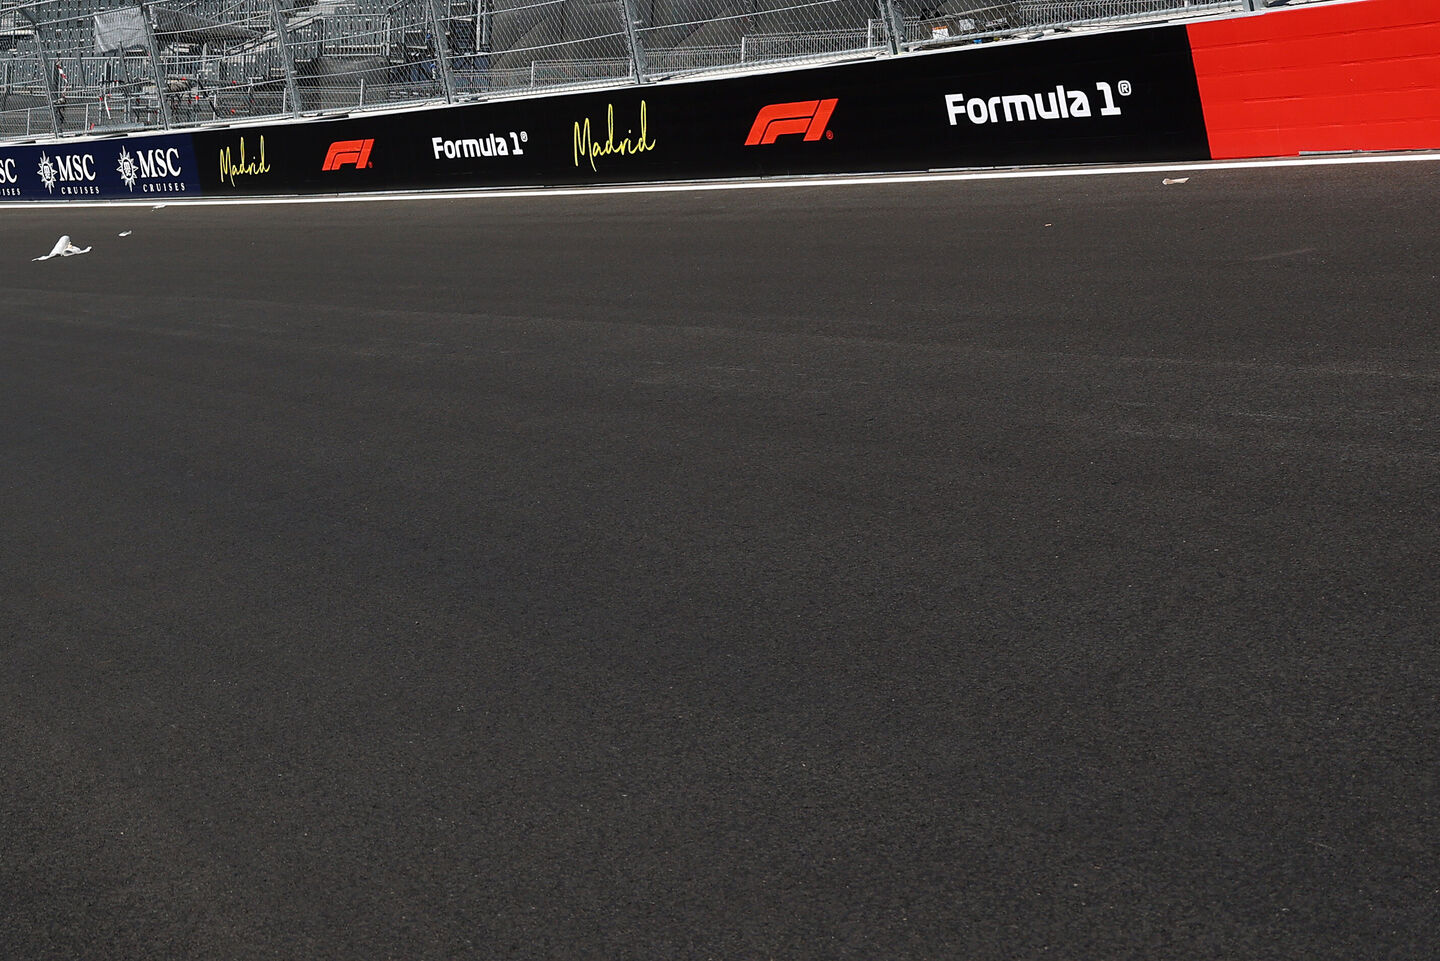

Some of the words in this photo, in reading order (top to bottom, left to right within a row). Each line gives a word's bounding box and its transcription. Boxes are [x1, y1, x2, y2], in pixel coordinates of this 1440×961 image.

[945, 85, 1091, 125] Formula
[432, 133, 508, 159] Formula
[573, 100, 656, 172] Madrid
[54, 154, 95, 181] MSC
[136, 148, 181, 178] MSC
[220, 134, 270, 187] Madrid
[143, 183, 185, 192] CRUISES
